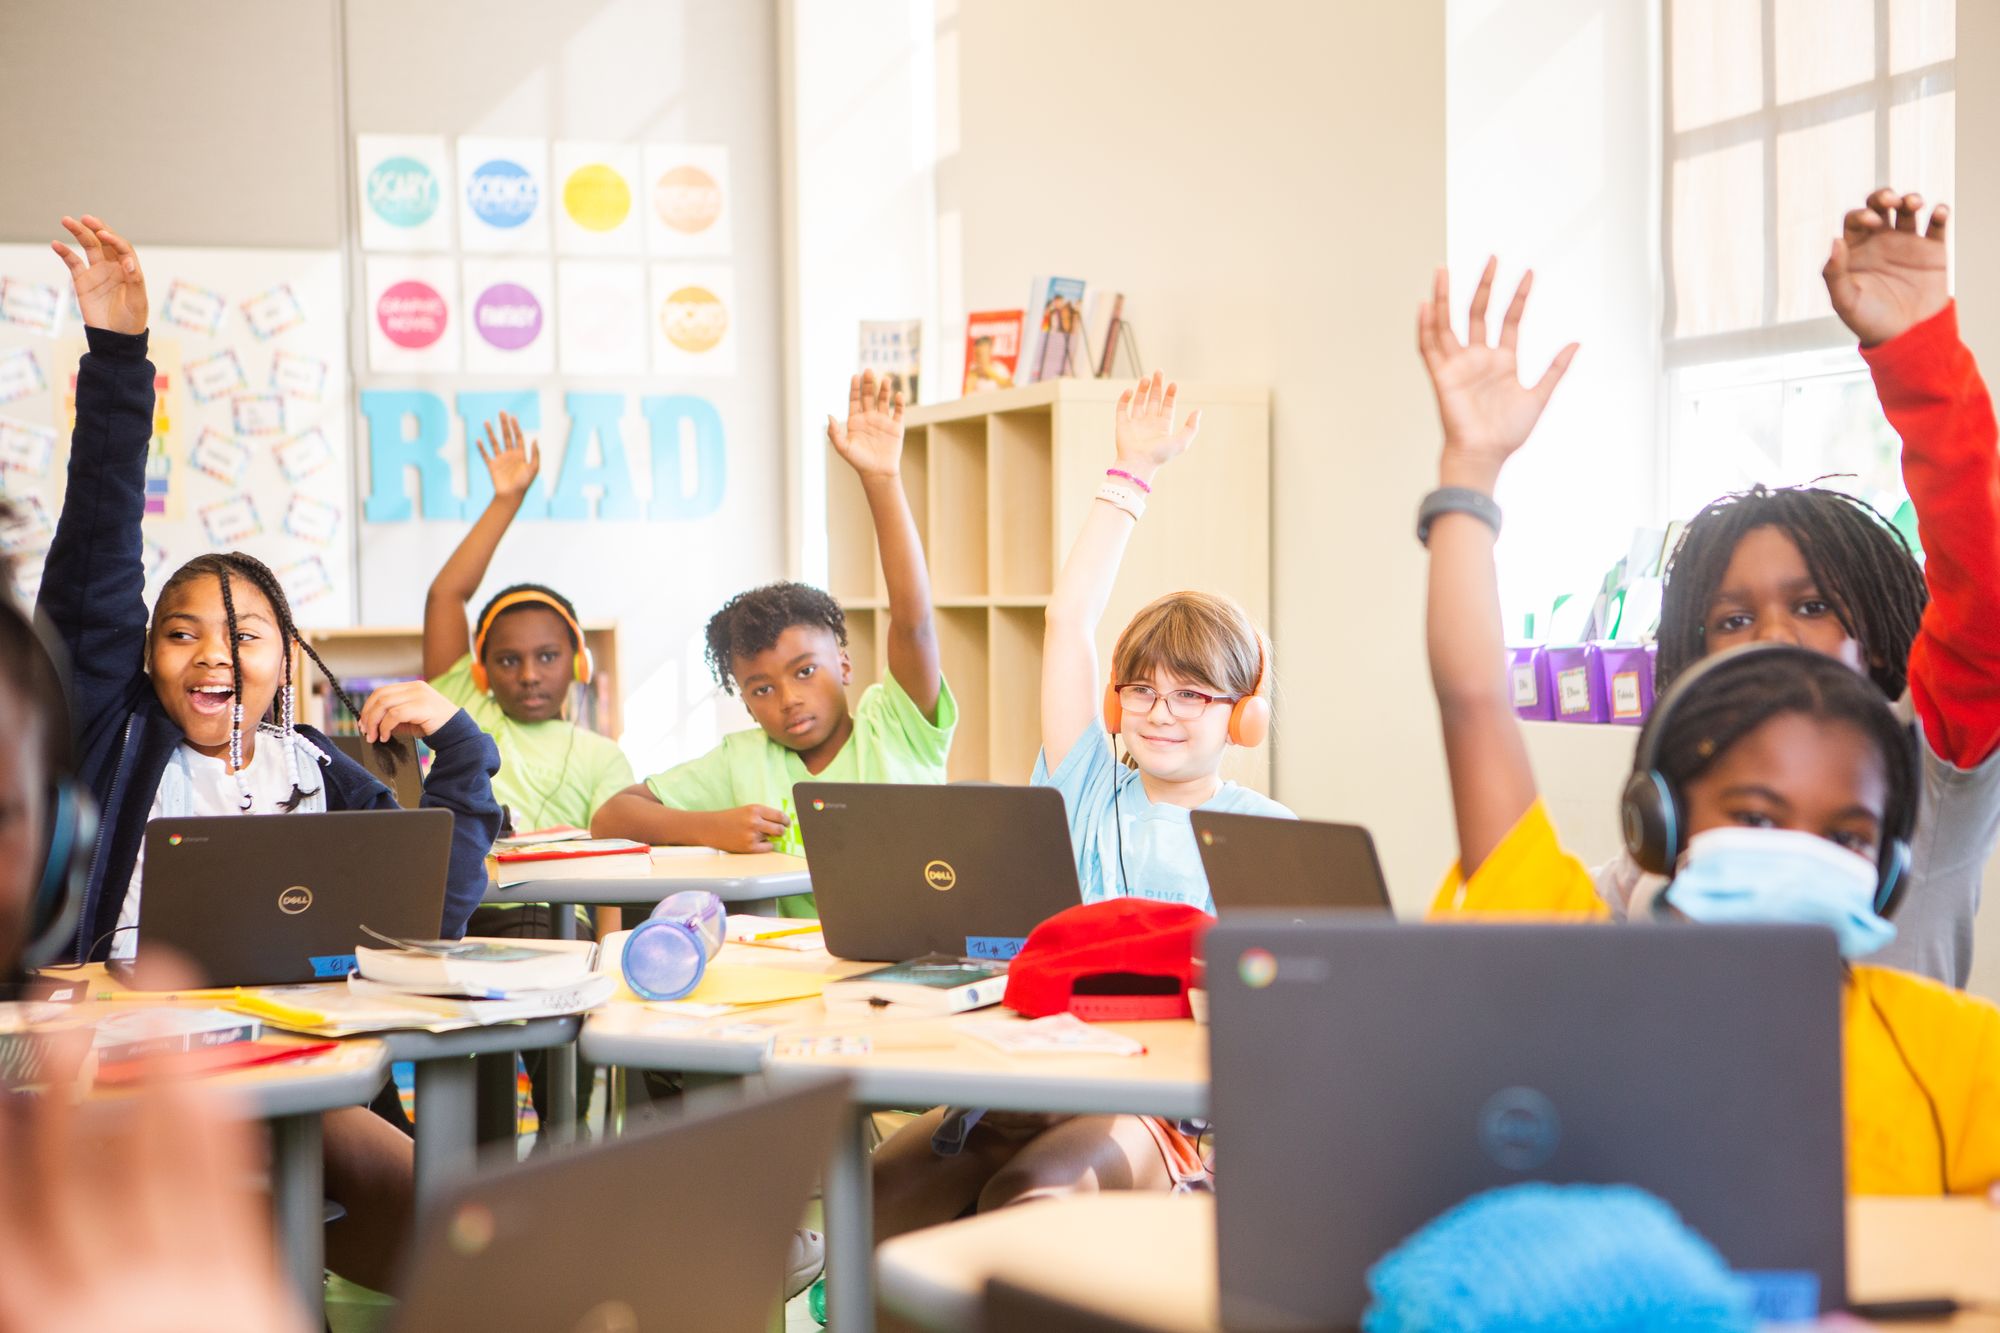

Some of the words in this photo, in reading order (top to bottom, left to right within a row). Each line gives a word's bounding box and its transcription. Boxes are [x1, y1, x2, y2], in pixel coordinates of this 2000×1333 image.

[368, 170, 435, 202] SCARY
[360, 389, 727, 523] READ
[928, 871, 952, 880] DELL
[283, 896, 309, 906] DELL
